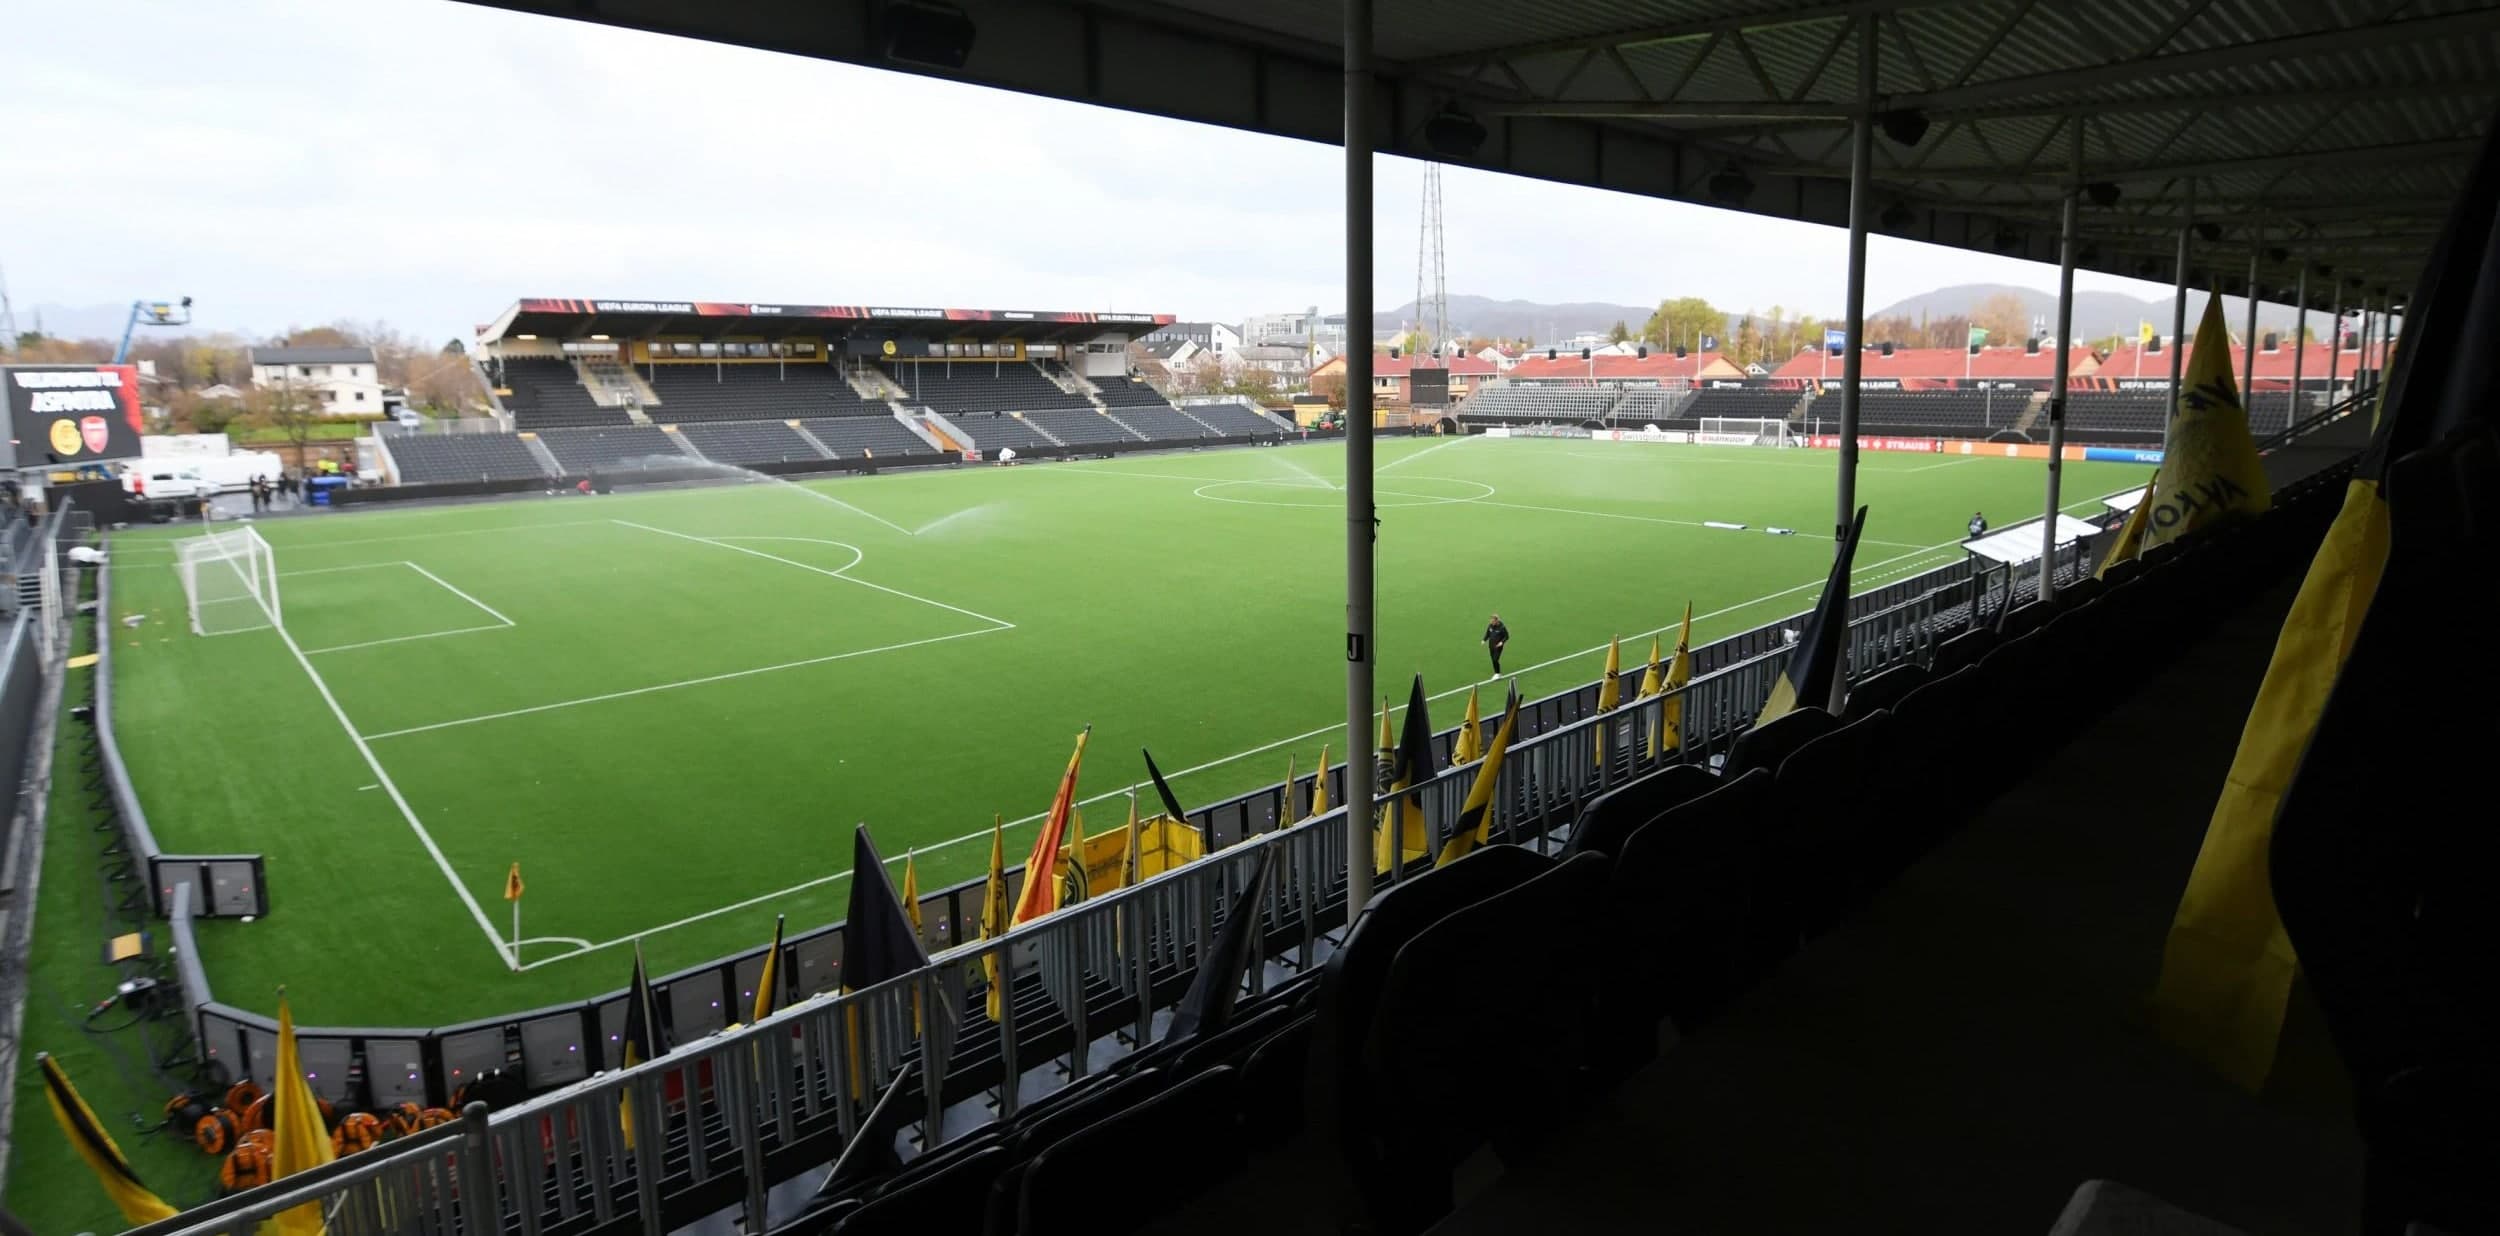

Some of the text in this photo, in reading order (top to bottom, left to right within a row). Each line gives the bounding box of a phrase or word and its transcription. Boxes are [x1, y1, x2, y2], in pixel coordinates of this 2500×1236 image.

[597, 302, 621, 311] UEFA
[2119, 381, 2144, 389] UEFA
[1886, 440, 1931, 450] STRAUSS
[1348, 635, 1358, 660] J
